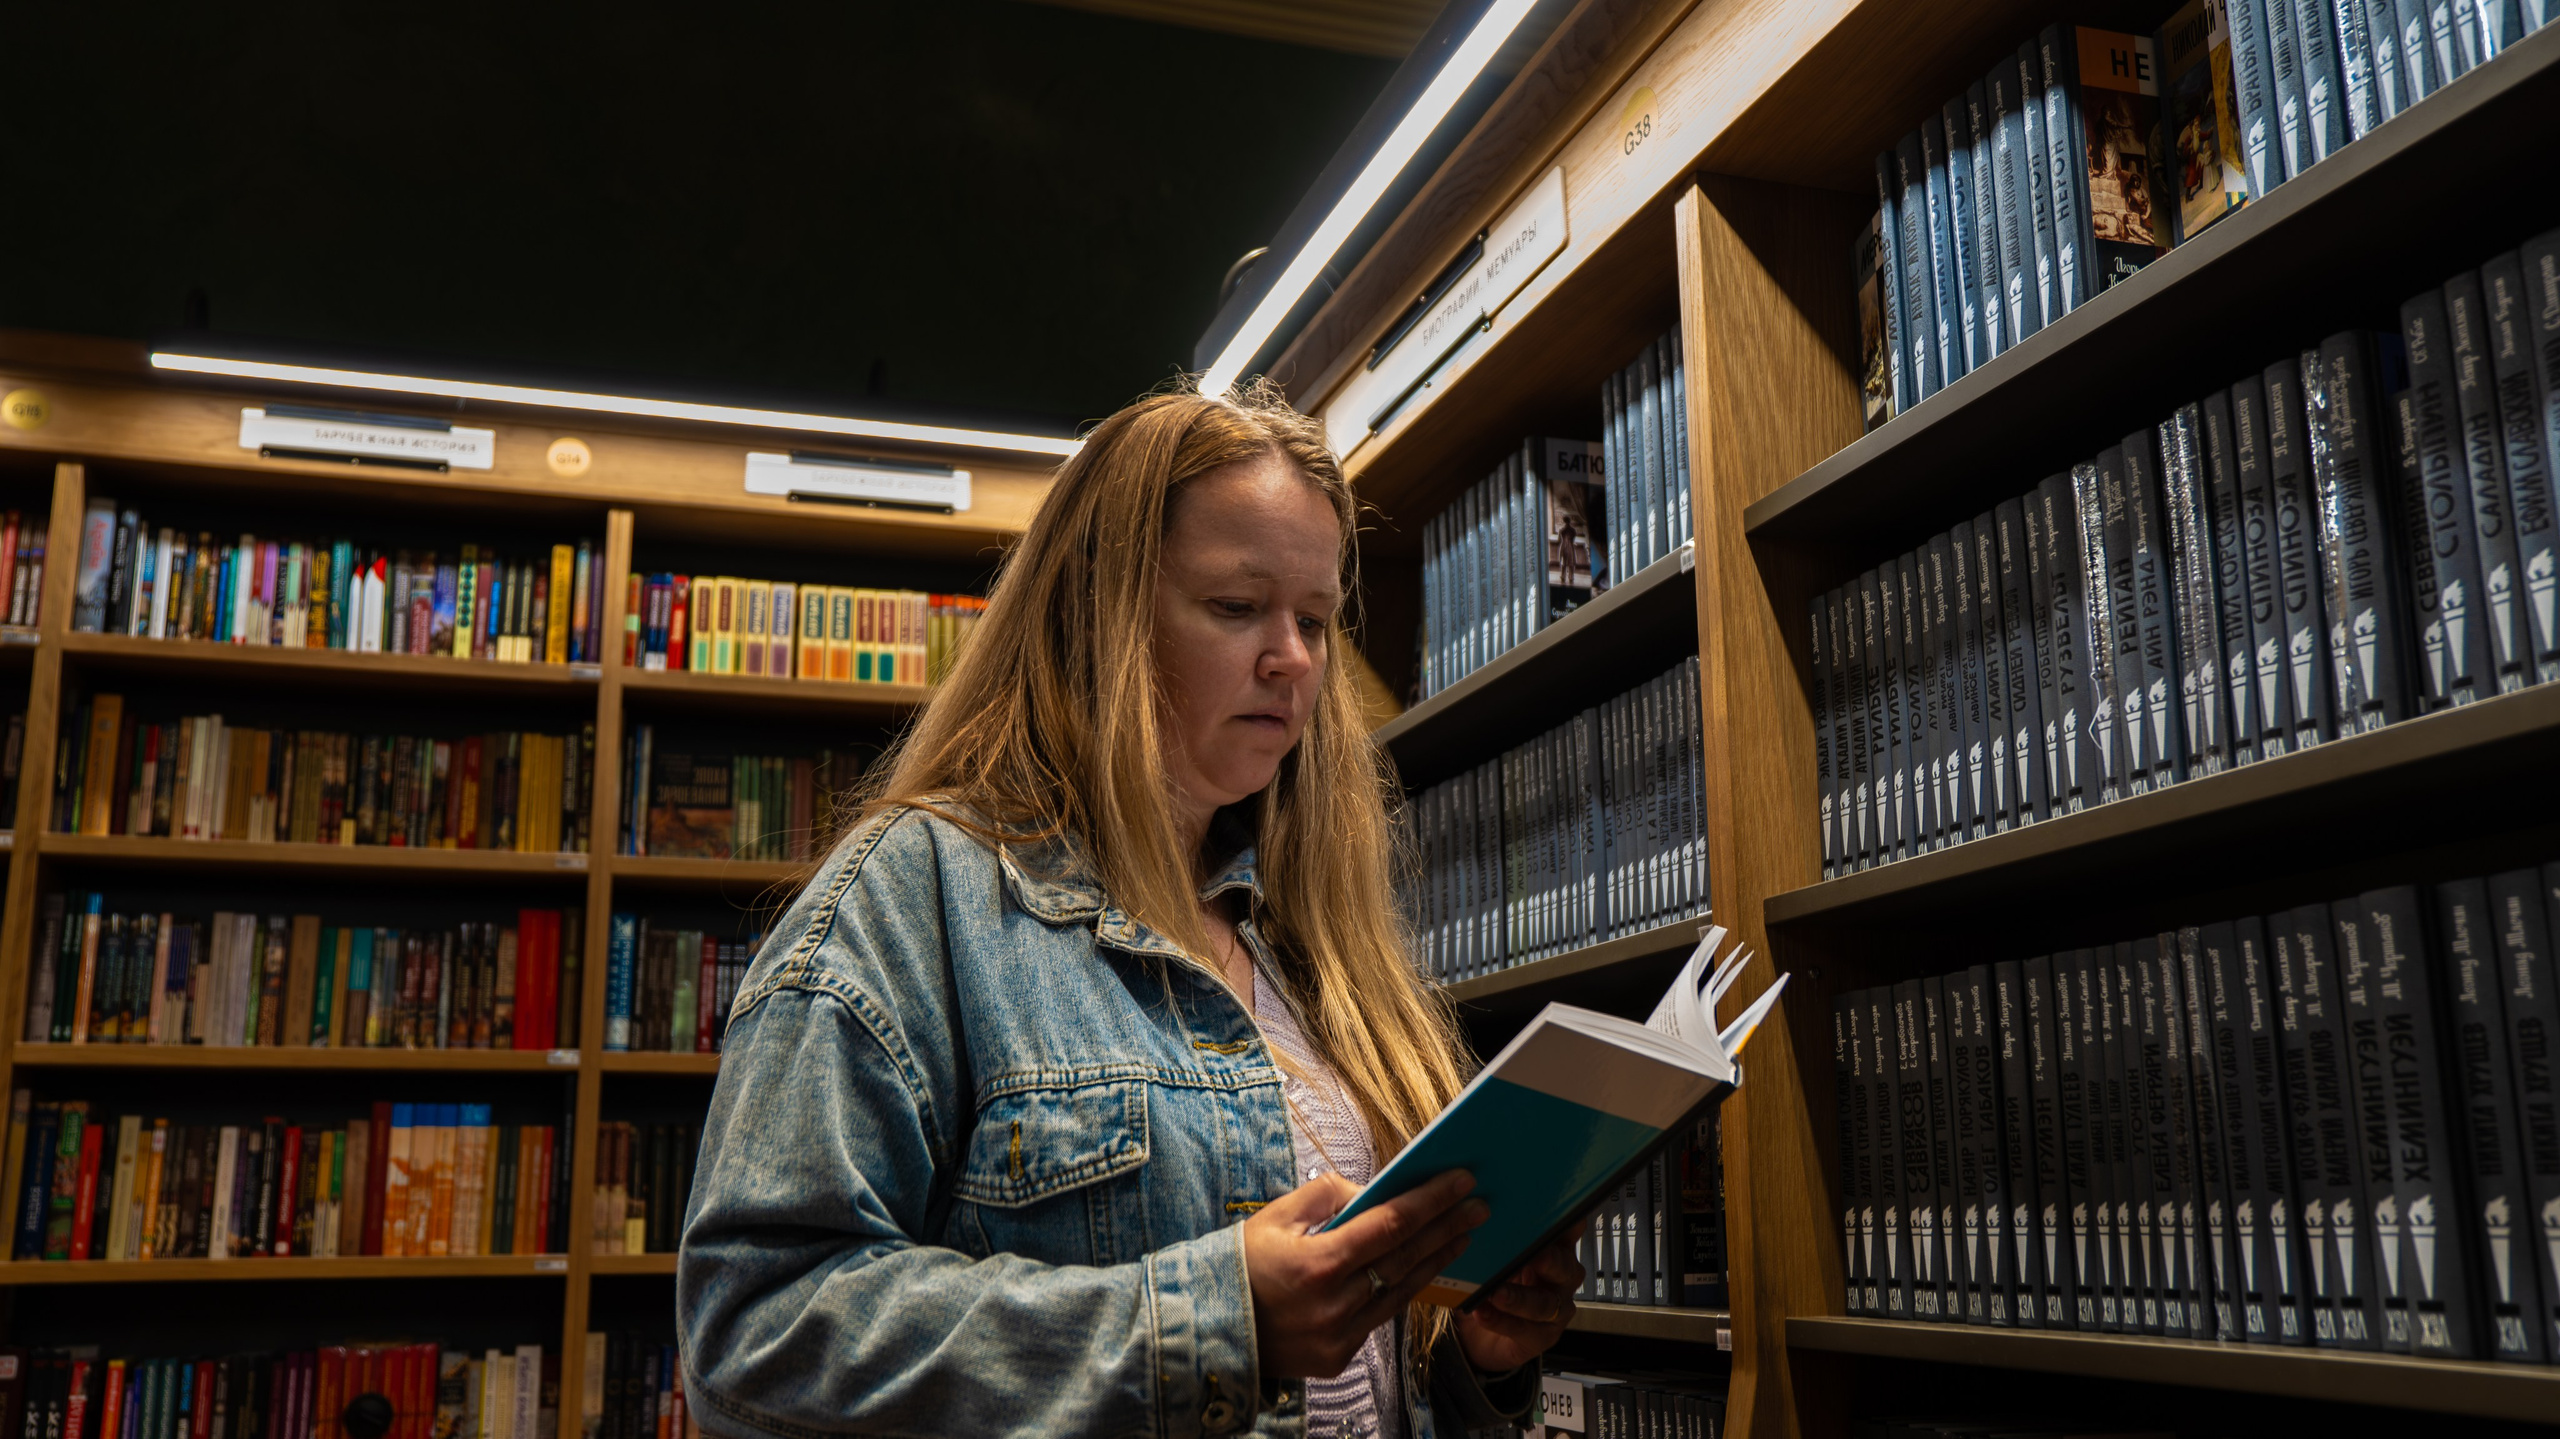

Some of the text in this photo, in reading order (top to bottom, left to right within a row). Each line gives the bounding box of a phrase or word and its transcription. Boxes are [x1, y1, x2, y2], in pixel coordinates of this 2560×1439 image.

[2111, 47, 2151, 83] НЕ
[2171, 0, 2217, 64] НИКОЛАЙ
[1624, 113, 1652, 156] G38
[2050, 140, 2071, 222] НЕРОН
[1974, 164, 1997, 286] АЛЕКСАНДР НЕВСКИЙ
[1997, 149, 2022, 269] АЛЕКСАНДР ОСТРОВСКИЙ
[2027, 154, 2047, 232] НЕРОН
[1486, 220, 1538, 283] МЕМУАРЫ
[1882, 238, 1898, 340] МАРЕСЬЕВ
[1904, 212, 1923, 321] АНАСТАС МИКОЯН
[1557, 450, 1605, 477] БАТЮ
[1630, 470, 1639, 502] ДАВИД
[1644, 416, 1655, 505] ВСЕВОЛОД БОБРОВ
[1677, 438, 1686, 470] ДАВИД
[2415, 380, 2461, 560] СТОЛЫПИН
[2467, 411, 2504, 538] САЛАДИН
[2498, 369, 2551, 537] ЕФИМ СЛАВСКИЙ
[2213, 491, 2245, 642] НИЛ СОРСКИЙ
[2240, 486, 2276, 624] СПИНОЗА
[2273, 472, 2310, 614] СПИНОЗА
[2336, 458, 2375, 601] ИГОРЬ СЕВЕРЯНИН
[2405, 476, 2440, 612] СЕВЕРЯНИН
[2004, 588, 2027, 712] СИДНЕЙ РЕЙЛИ
[2035, 602, 2053, 690] РОБЕСПЬЕР
[2050, 571, 2076, 696] РУЗВЕЛЬТ
[2110, 558, 2139, 656] РЕЙГАН
[2138, 559, 2164, 670] АЙН РЭНД
[1867, 666, 1885, 755] РИЛЬКЕ
[1885, 657, 1903, 747] РИЛЬКЕ
[1906, 664, 1924, 742] РОМУЛ
[1925, 655, 1938, 730] ЛУИ РЕНО
[1939, 673, 1947, 709] РИЧАРД
[1943, 639, 1958, 732] ЛЬВИНОЕ СЕРДЦЕ
[1961, 663, 1970, 701] РИЧАРД
[1965, 629, 1981, 723] ЛЬВИНОЕ СЕРДЦЕ
[1983, 615, 2002, 721] МАЙН РИД
[1815, 678, 1831, 779] ЭЛЬДАР РЯЗАНОВ
[1585, 783, 1595, 854] ГЛИНКА
[1605, 817, 1613, 848] ВАН
[1645, 765, 1658, 841] ГАПОН
[1659, 799, 1669, 845] ЧЕРУБИНА
[1668, 755, 1678, 832] ПАТРИАРХ ГЕРМОГЕН
[1678, 737, 1692, 839] ГЕОРГИЙ ПОБЕДОНОСЕЦ
[1465, 823, 1473, 908] ВОРОШИЛОВ
[1490, 815, 1498, 899] ВАШИНГТОН
[1997, 982, 2017, 1060] Игорь Князький
[2280, 996, 2302, 1032] Петр
[1836, 1070, 1857, 1197] АПОЛЛИНАРИЯ СУСЛОВА
[1854, 1084, 1872, 1199] ЭДУАРД СТРЕЛЬЦОВ
[1877, 1082, 1896, 1199] ЭДУАРД СТРЕЛЬЦОВ
[1902, 1082, 1918, 1193] САВРАСОВ
[1912, 1080, 1930, 1193] САВРАСОВ
[1932, 1077, 1950, 1187] МИХАИЛ ТВЕРСКОЙ
[1954, 1045, 1977, 1196] НАЗИР ТЮРЯКУЛОВ
[1975, 1045, 1998, 1194] ОЛЕГ ТАБАКОВ
[2006, 1096, 2023, 1180] ТИБЕРИЙ
[2035, 1098, 2057, 1189] ТРУМЭН
[2062, 1071, 2087, 1189] АМАН ТУЛЕЕВ
[2087, 1080, 2106, 1164] ЭЛИЗАБЕТ ТЕЙЛОР
[2108, 1078, 2126, 1164] ЭЛИЗАБЕТ ТЕЙЛОР
[2127, 1068, 2145, 1156] УТОЧКИН
[2143, 1043, 2172, 1193] ЕЛЕНА ФЕРРАРИ
[2170, 1076, 2190, 1185] КИМ ФИЛБИ
[2195, 1074, 2219, 1183] КИМ ФИЛБИ
[2216, 1028, 2251, 1191] ВИЛЬЯМ ФИШЕР (АБЕЛЬ)
[2252, 1036, 2285, 1195] МИТРОПОЛИТ ФИЛИПП
[2286, 1048, 2319, 1180] ИОСИФ ФЛАВИЙ
[2308, 1029, 2352, 1187] ВАЛЕРИЙ ХАРЛАМОВ
[2351, 1018, 2394, 1184] ХЕМИНГУЭЙ
[2382, 1012, 2432, 1183] ХЕМИНГУЭЙ
[2461, 1021, 2503, 1176] НИКИТА ХРУЩЕВ
[2516, 1017, 2560, 1175] НИКИТА ХРУЩЕВ
